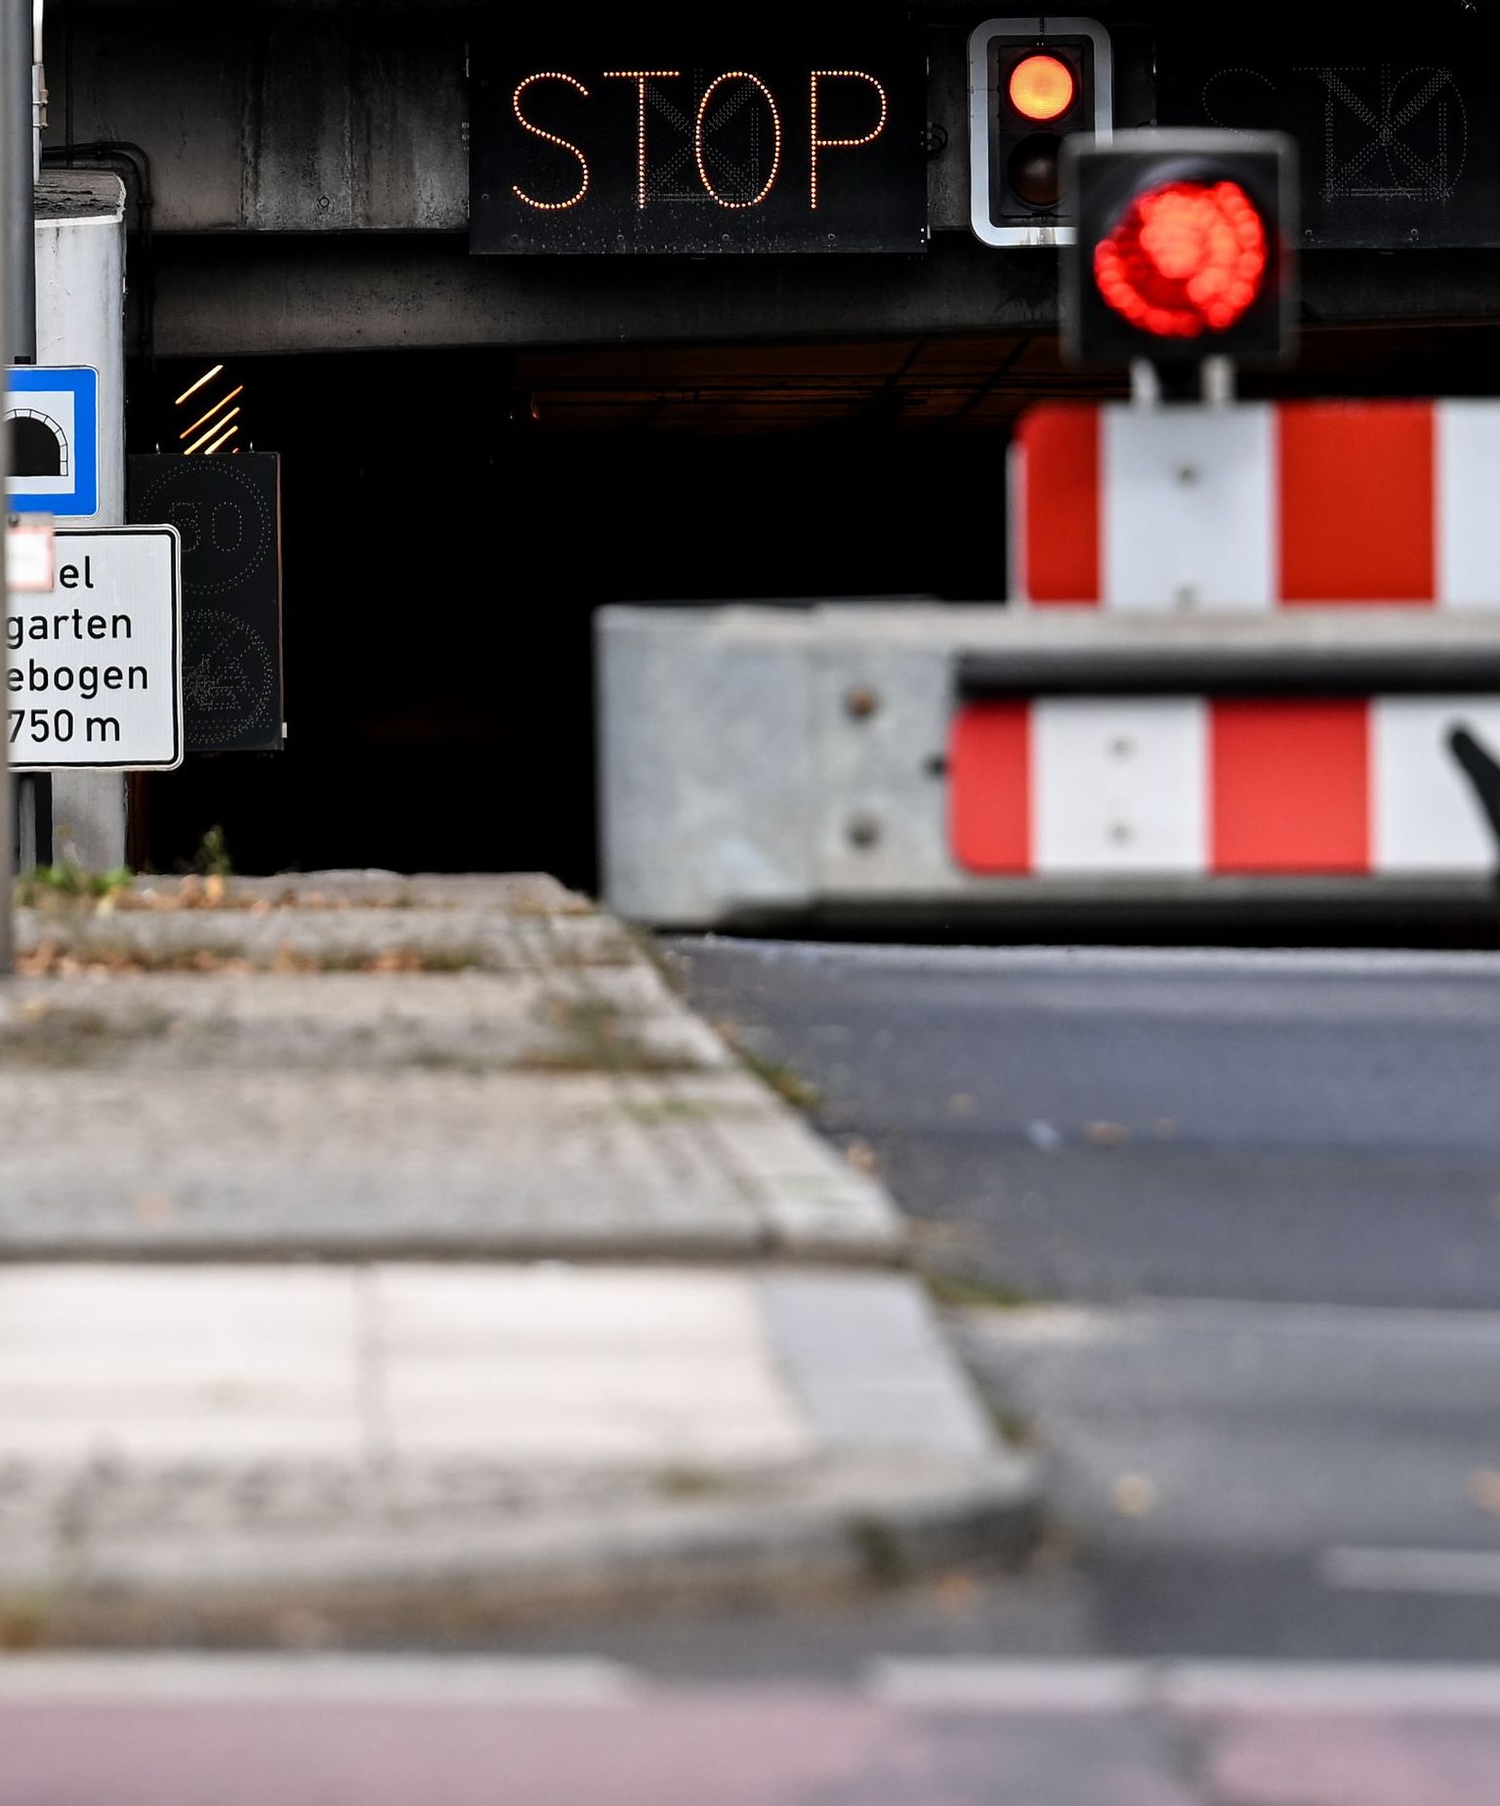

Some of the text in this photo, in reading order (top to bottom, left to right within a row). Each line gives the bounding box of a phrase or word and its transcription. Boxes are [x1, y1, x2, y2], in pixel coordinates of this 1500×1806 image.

[511, 68, 888, 211] STOP
[6, 608, 132, 650] garten
[6, 658, 148, 700] ebogen
[86, 716, 120, 742] m
